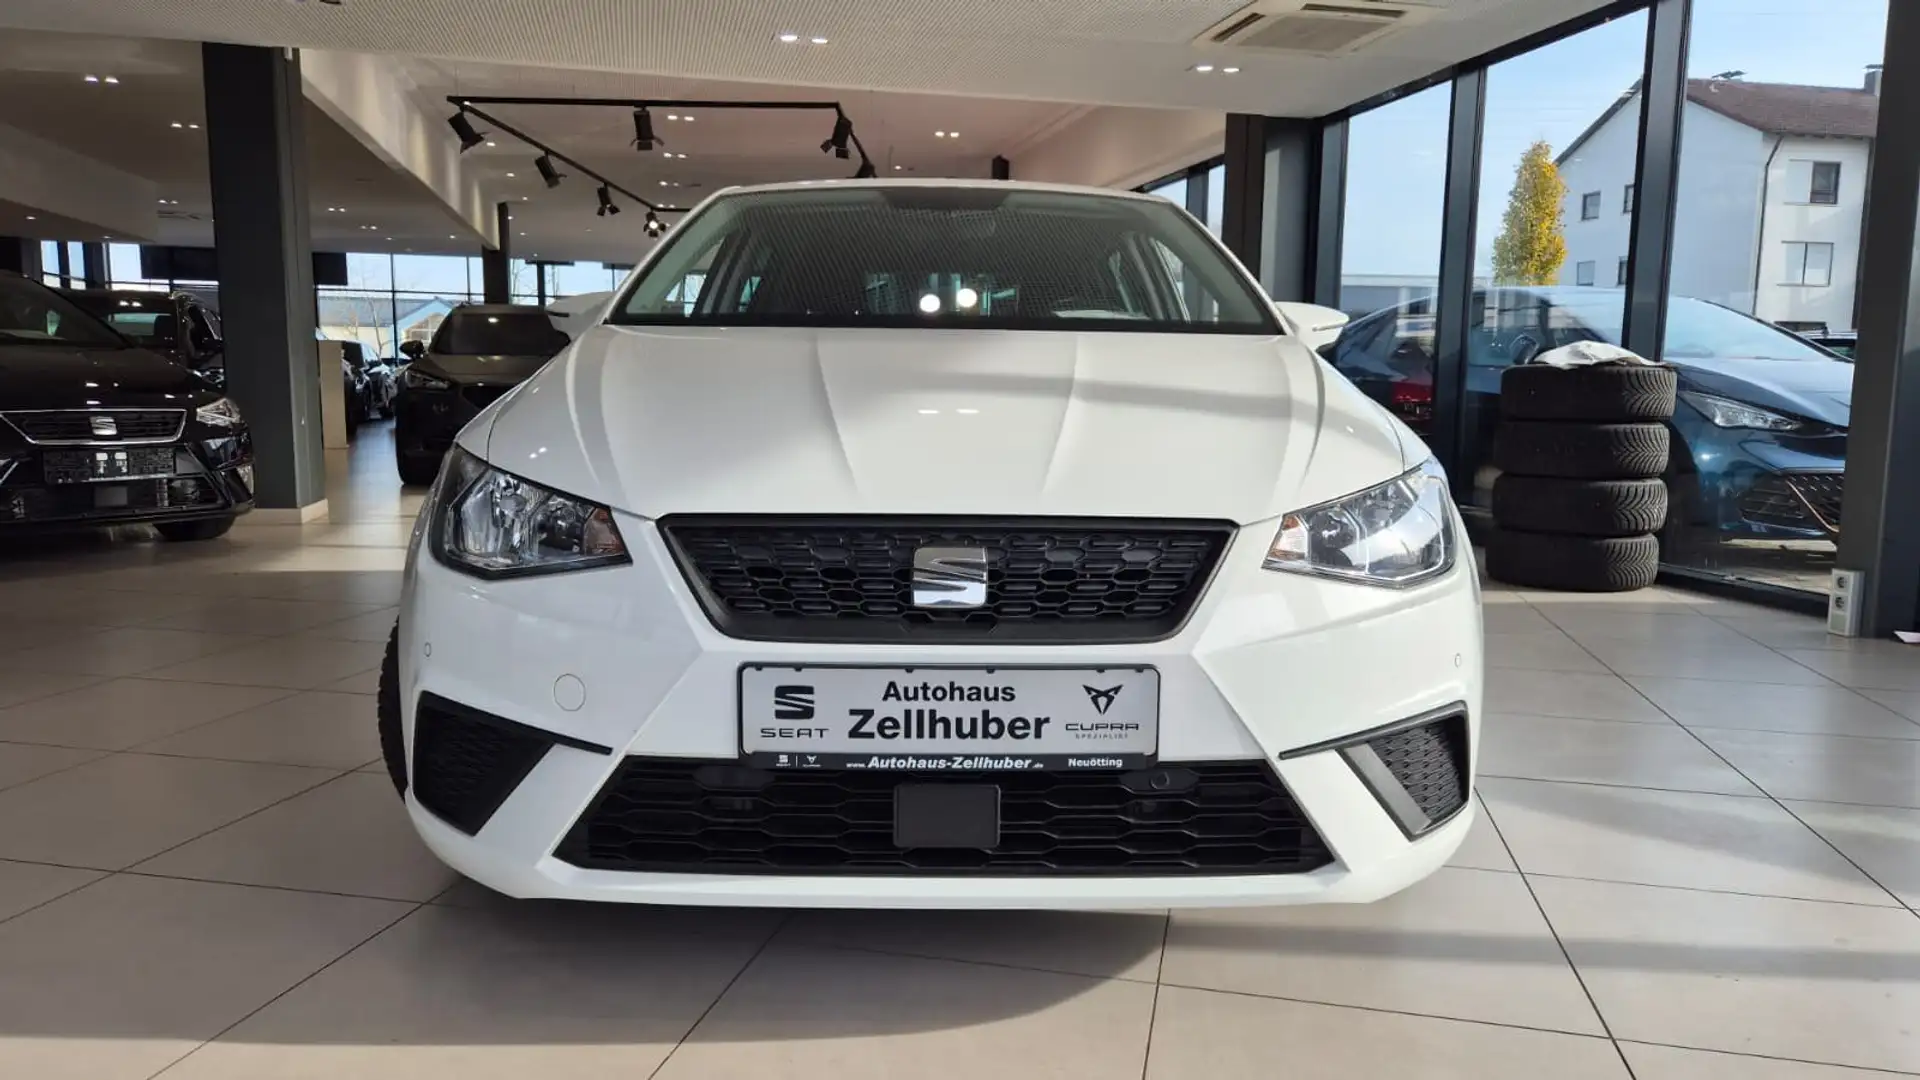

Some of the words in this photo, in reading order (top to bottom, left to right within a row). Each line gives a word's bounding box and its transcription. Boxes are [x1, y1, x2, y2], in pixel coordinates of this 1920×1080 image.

[882, 681, 1016, 702] Autohaus
[847, 709, 1051, 740] Zellhuber
[1065, 723, 1140, 731] CUPRA
[760, 728, 830, 739] SEAT
[1067, 758, 1123, 768] Neuötting
